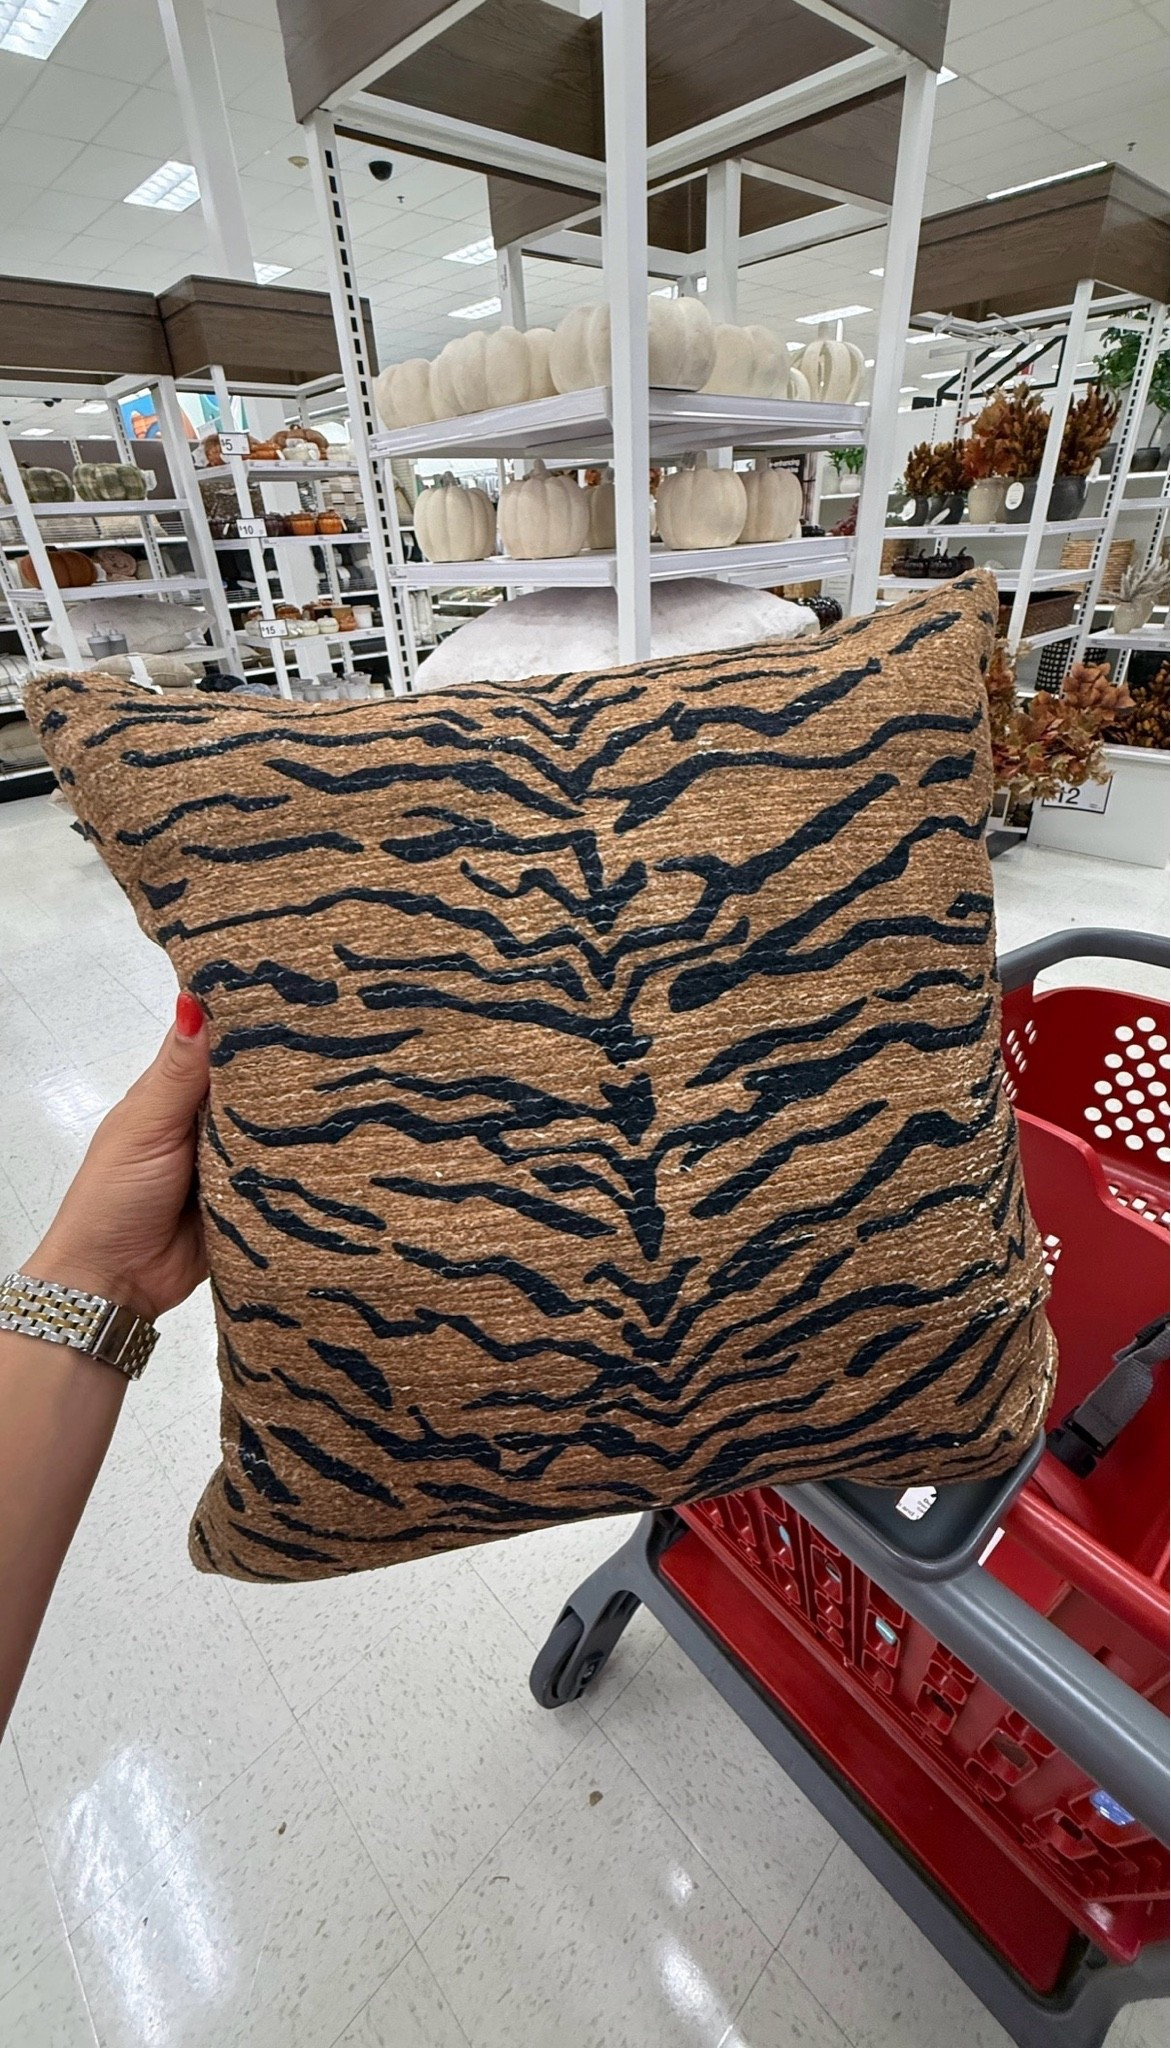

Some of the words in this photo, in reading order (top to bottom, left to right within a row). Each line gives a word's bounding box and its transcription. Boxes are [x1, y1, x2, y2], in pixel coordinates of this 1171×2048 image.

[221, 438, 233, 451] $5
[239, 525, 254, 535] $10
[261, 625, 276, 635] $15
[1056, 785, 1080, 805] 12
